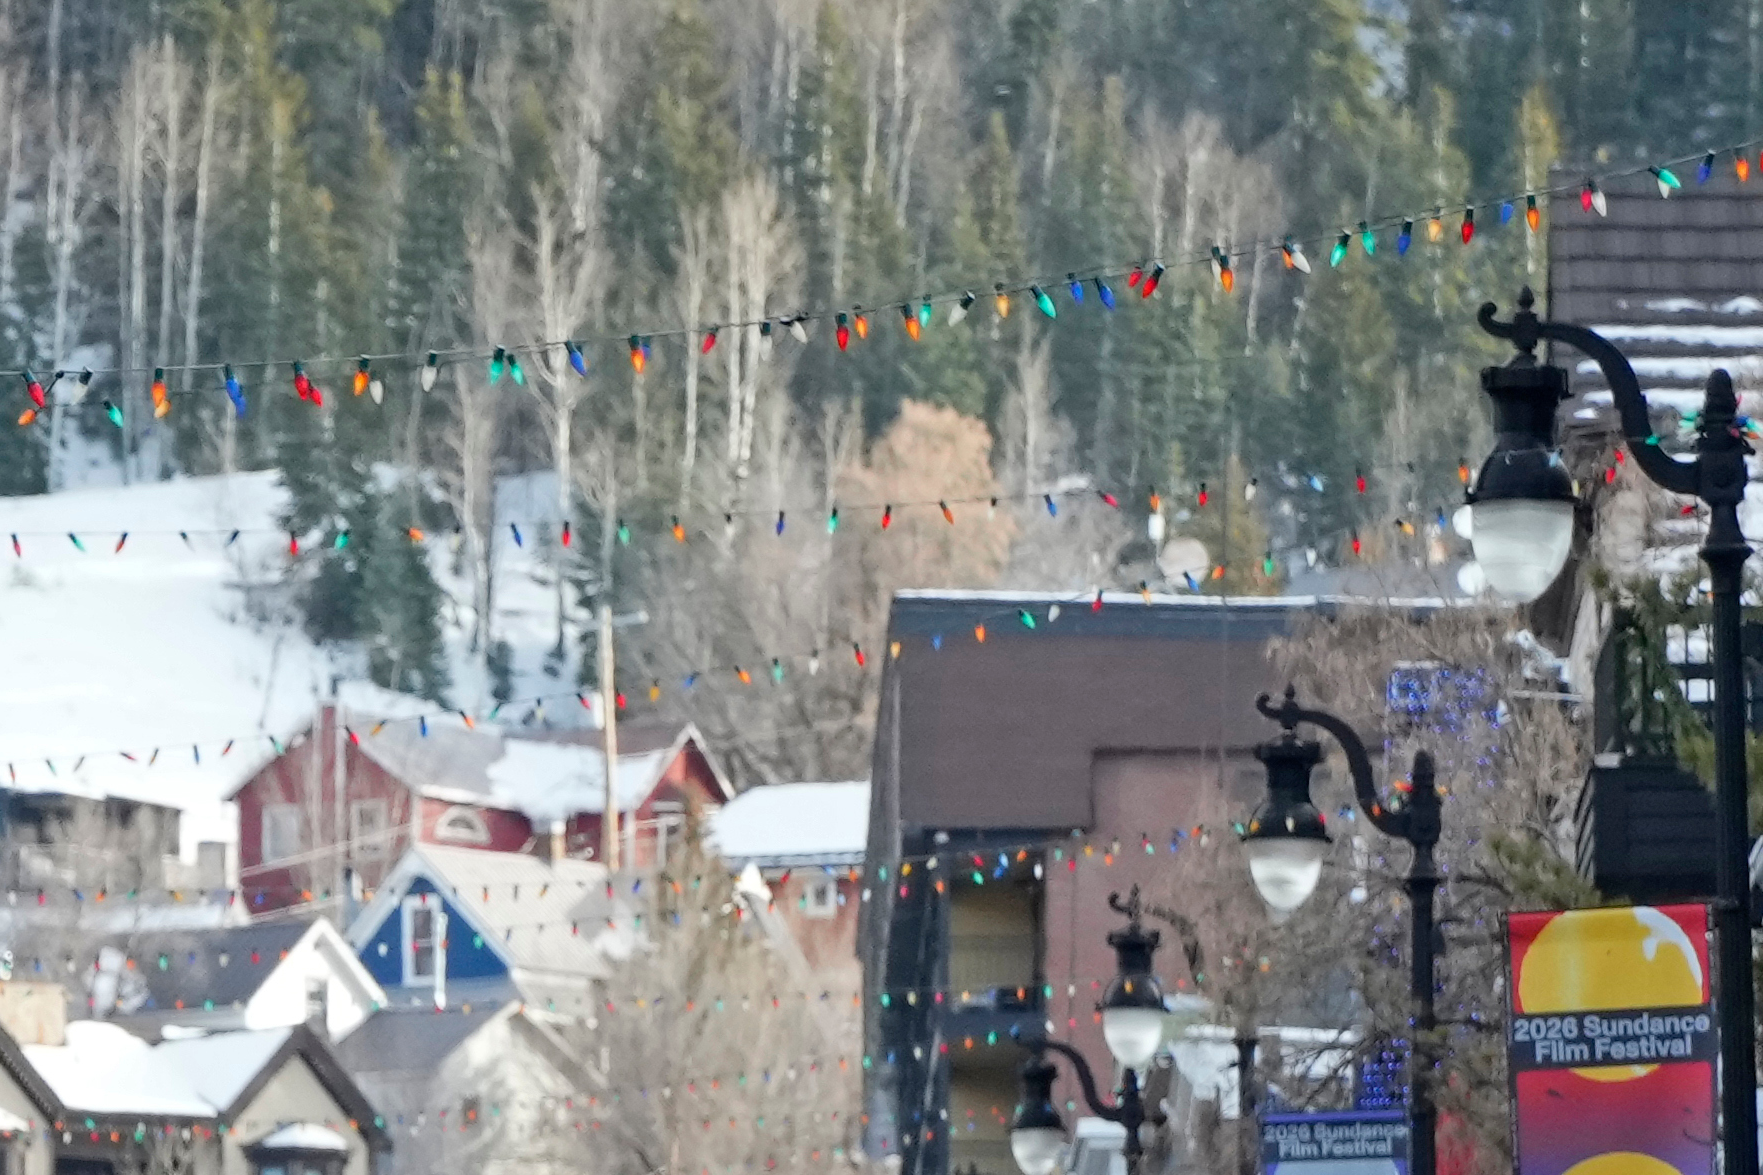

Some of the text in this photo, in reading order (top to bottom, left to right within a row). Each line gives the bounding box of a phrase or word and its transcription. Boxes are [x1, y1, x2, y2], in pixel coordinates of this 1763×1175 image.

[1513, 1012, 1710, 1042] 2026 Sundance
[1535, 1034, 1692, 1063] Film Festival
